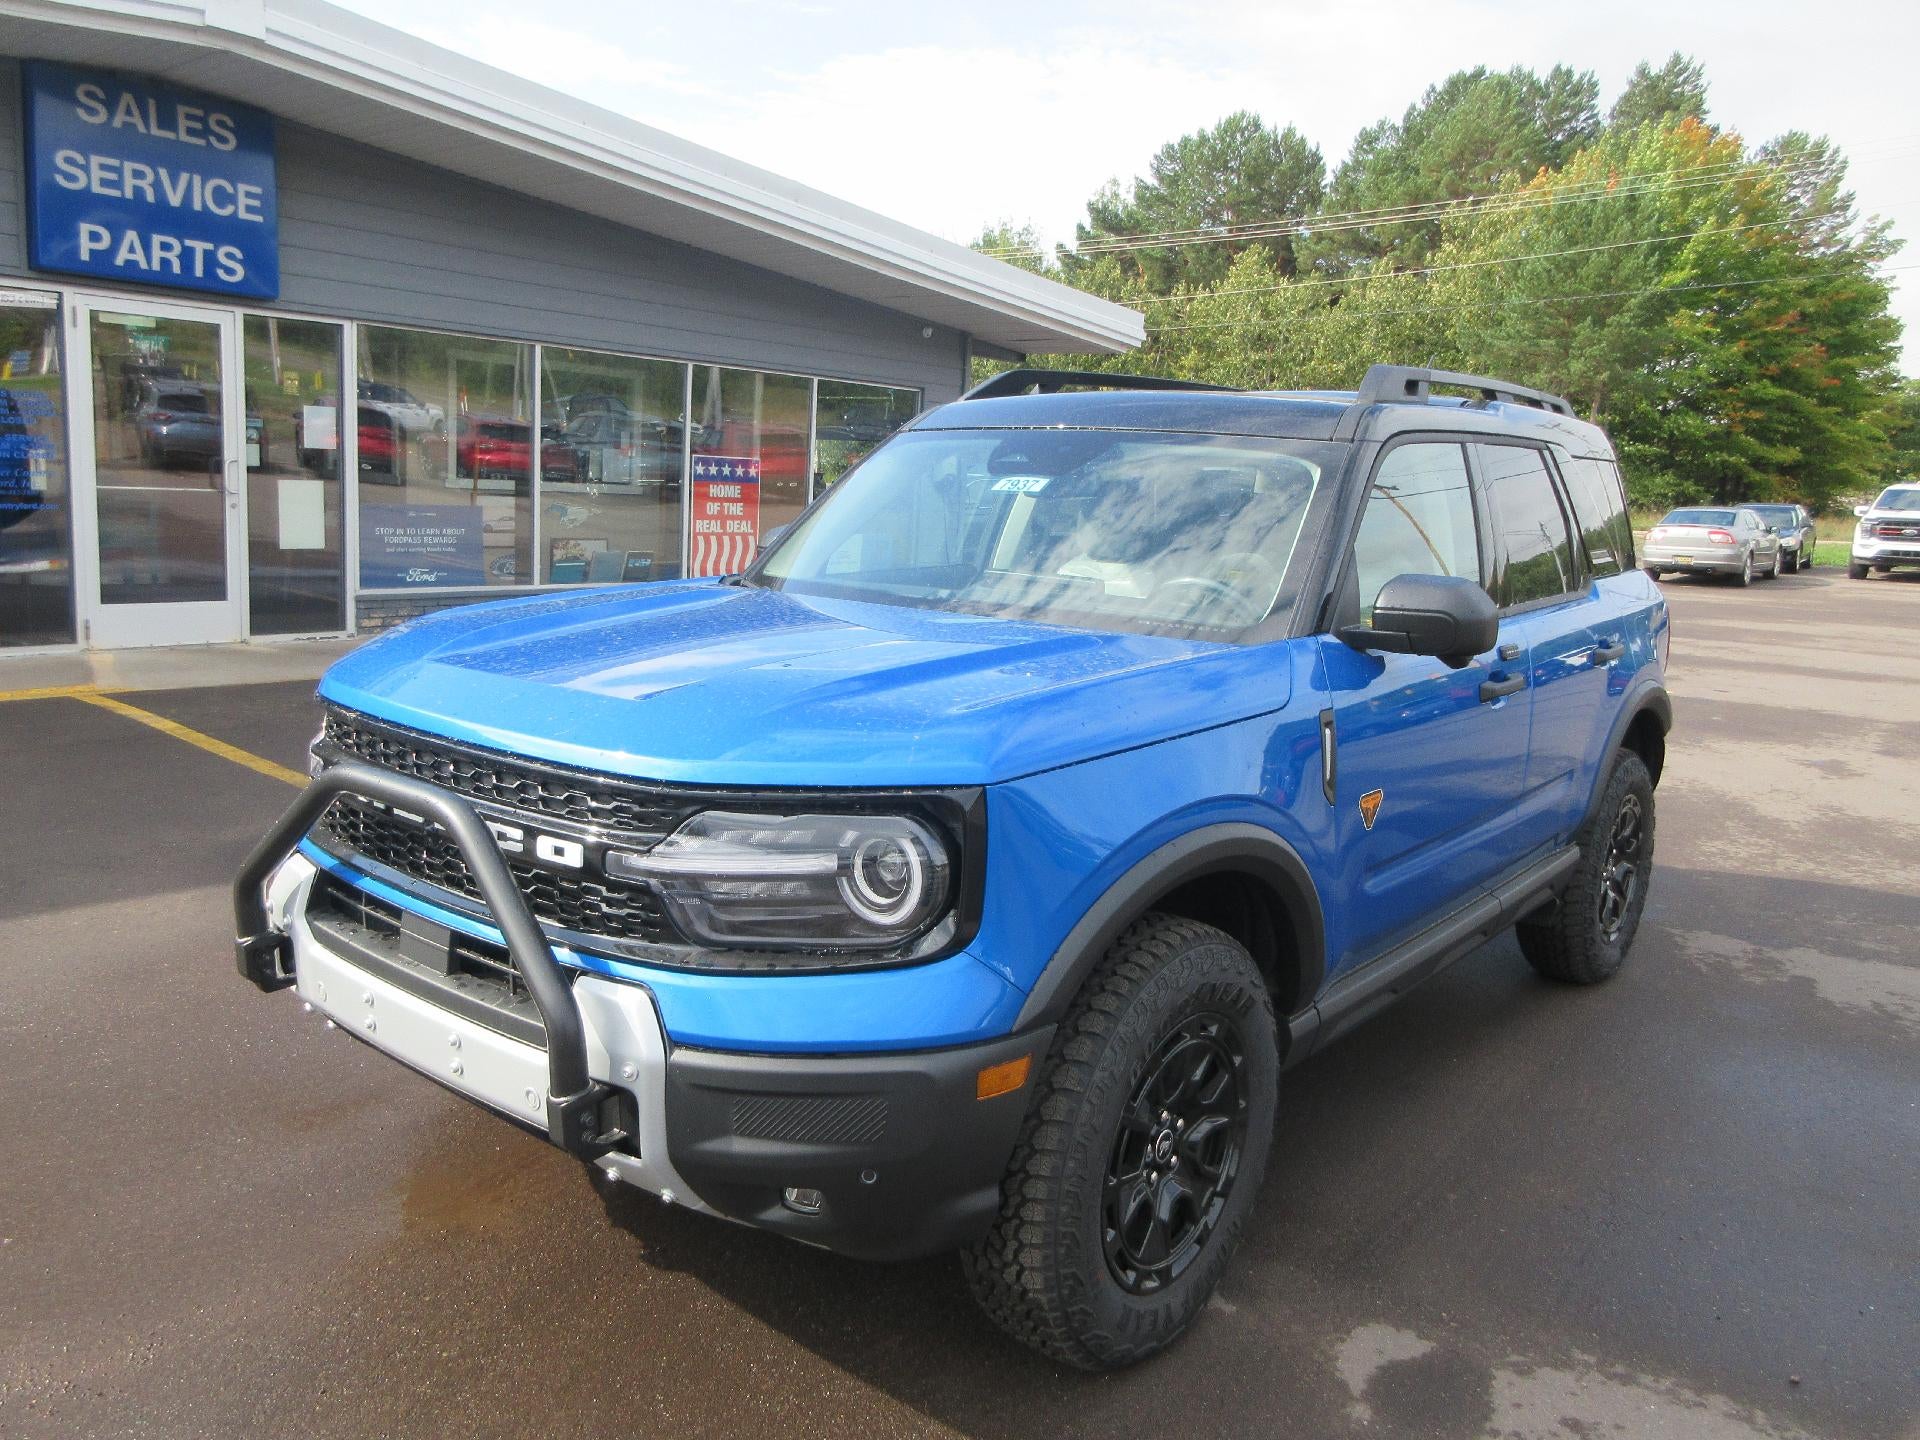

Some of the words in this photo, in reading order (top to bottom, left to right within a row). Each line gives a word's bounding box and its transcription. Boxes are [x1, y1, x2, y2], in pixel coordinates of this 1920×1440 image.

[75, 83, 238, 151] SALES
[53, 150, 264, 223] SERVICE
[79, 222, 245, 283] PARTS
[709, 484, 742, 498] HOME
[1000, 479, 1040, 490] 7937
[706, 502, 721, 515] OF
[723, 502, 744, 516] THE
[375, 527, 394, 535] STOP
[396, 527, 404, 535] IN
[696, 519, 723, 533] REAL
[726, 520, 753, 533] DEAL
[406, 567, 438, 582] Ford
